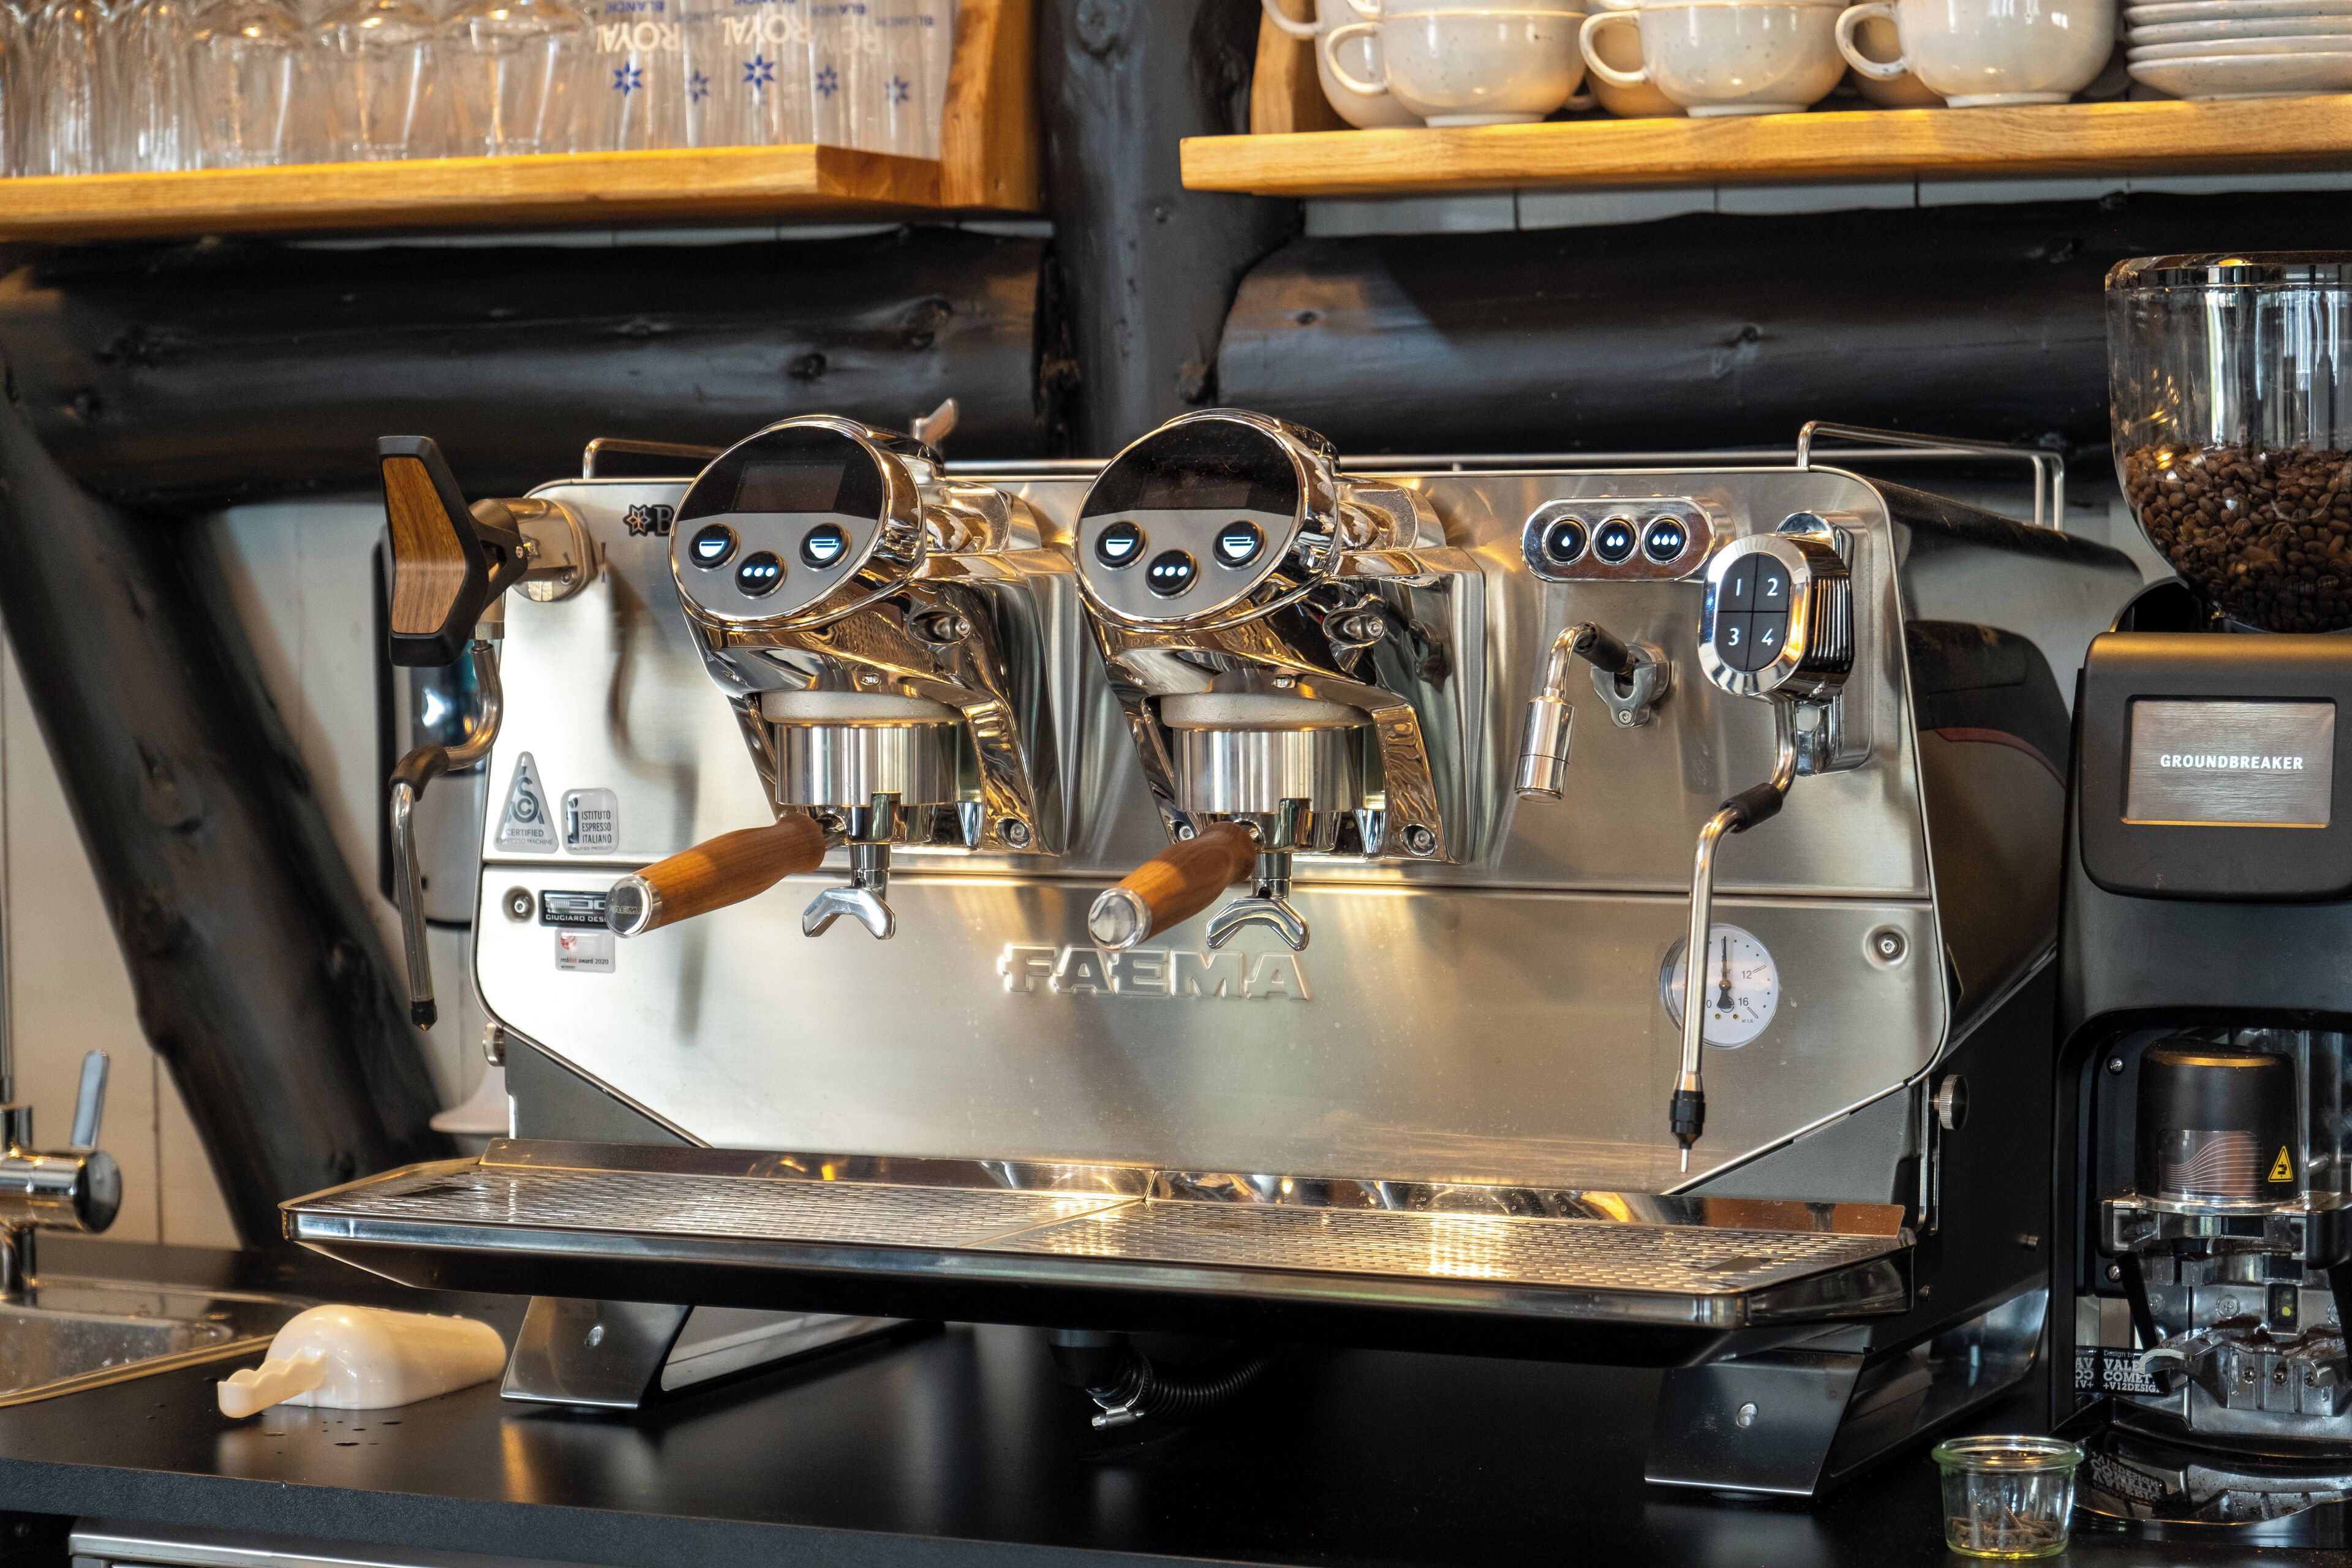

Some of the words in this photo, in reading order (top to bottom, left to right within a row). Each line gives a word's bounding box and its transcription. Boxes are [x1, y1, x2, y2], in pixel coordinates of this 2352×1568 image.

[722, 14, 812, 46] ROYAL
[1735, 578, 1741, 597] 1
[1766, 578, 1779, 597] 2
[1727, 627, 1740, 646] 3
[1761, 628, 1774, 646] 4
[2160, 754, 2304, 770] GROUNDBREAKER
[581, 810, 611, 821] ISTITUTO
[582, 822, 611, 832] ESPRESSO
[506, 829, 544, 837] CERTIFIED
[582, 834, 612, 843] ITALIANO
[998, 944, 1309, 1000] FAEMA
[1741, 970, 1752, 979] 12
[1738, 997, 1749, 1006] 16
[2103, 1349, 2126, 1358] Design
[2127, 1351, 2135, 1359] by
